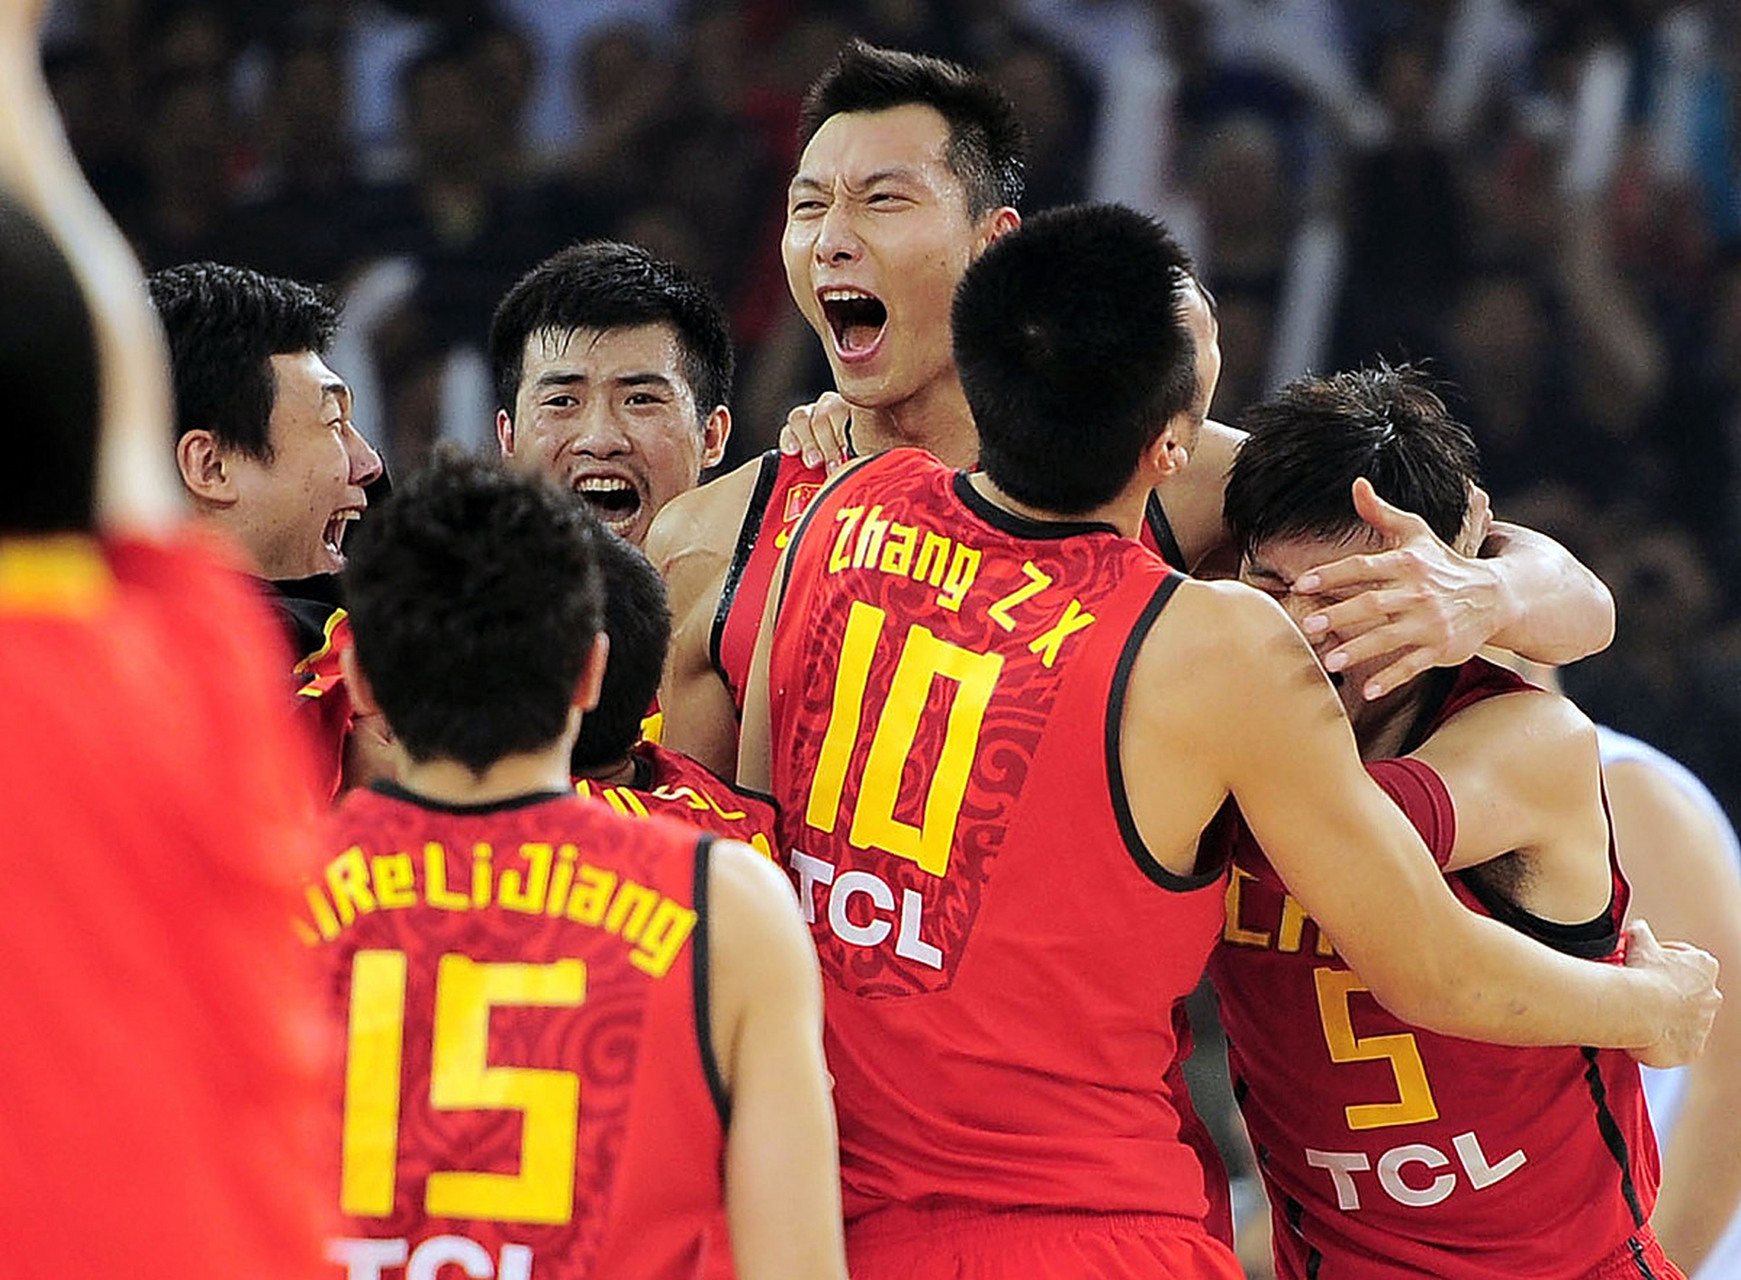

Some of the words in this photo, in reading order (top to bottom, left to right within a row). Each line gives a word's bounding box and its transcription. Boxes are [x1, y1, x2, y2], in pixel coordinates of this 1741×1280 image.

[829, 504, 982, 613] Zhang
[987, 560, 1053, 632] Z
[806, 600, 1005, 878] 10
[291, 841, 697, 978] iReLiJiang
[789, 847, 942, 970] TCL
[340, 950, 588, 1226] 15
[1313, 967, 1439, 1130] 5
[1305, 1131, 1528, 1211] TCL
